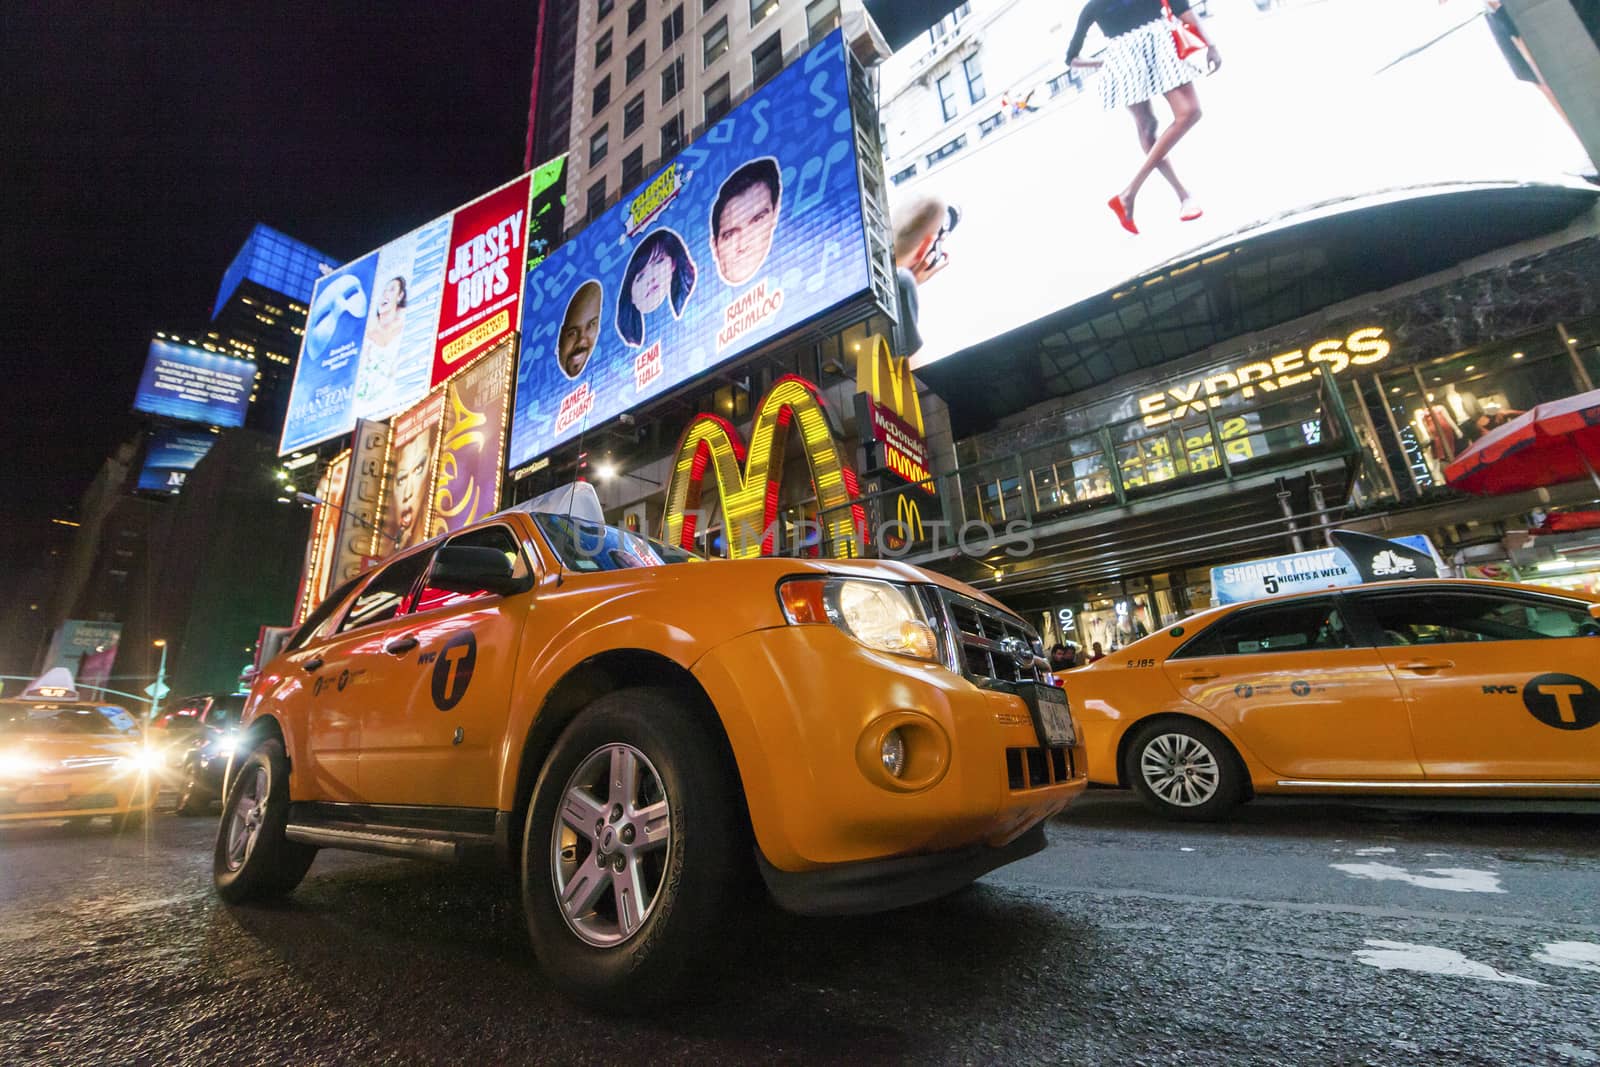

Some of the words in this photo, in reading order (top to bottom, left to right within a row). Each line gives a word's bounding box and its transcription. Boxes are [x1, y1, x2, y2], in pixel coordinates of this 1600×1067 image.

[448, 209, 523, 284] JERSEY
[456, 256, 510, 318] BOYS
[727, 283, 765, 321] RAMIN
[718, 291, 781, 349] KARIMLOO
[637, 343, 659, 372] LENA
[638, 364, 660, 388] HALL
[1138, 327, 1392, 428] EXPRESS
[560, 383, 587, 414] JAMES
[1223, 561, 1282, 584] SHARK
[1282, 551, 1338, 576] TANK
[1263, 575, 1279, 594] 5
[1278, 572, 1312, 584] NIGHTS
[1313, 570, 1320, 579] A
[1321, 566, 1348, 578] WEEK
[417, 651, 438, 665] NYC
[1482, 684, 1518, 694] NYC
